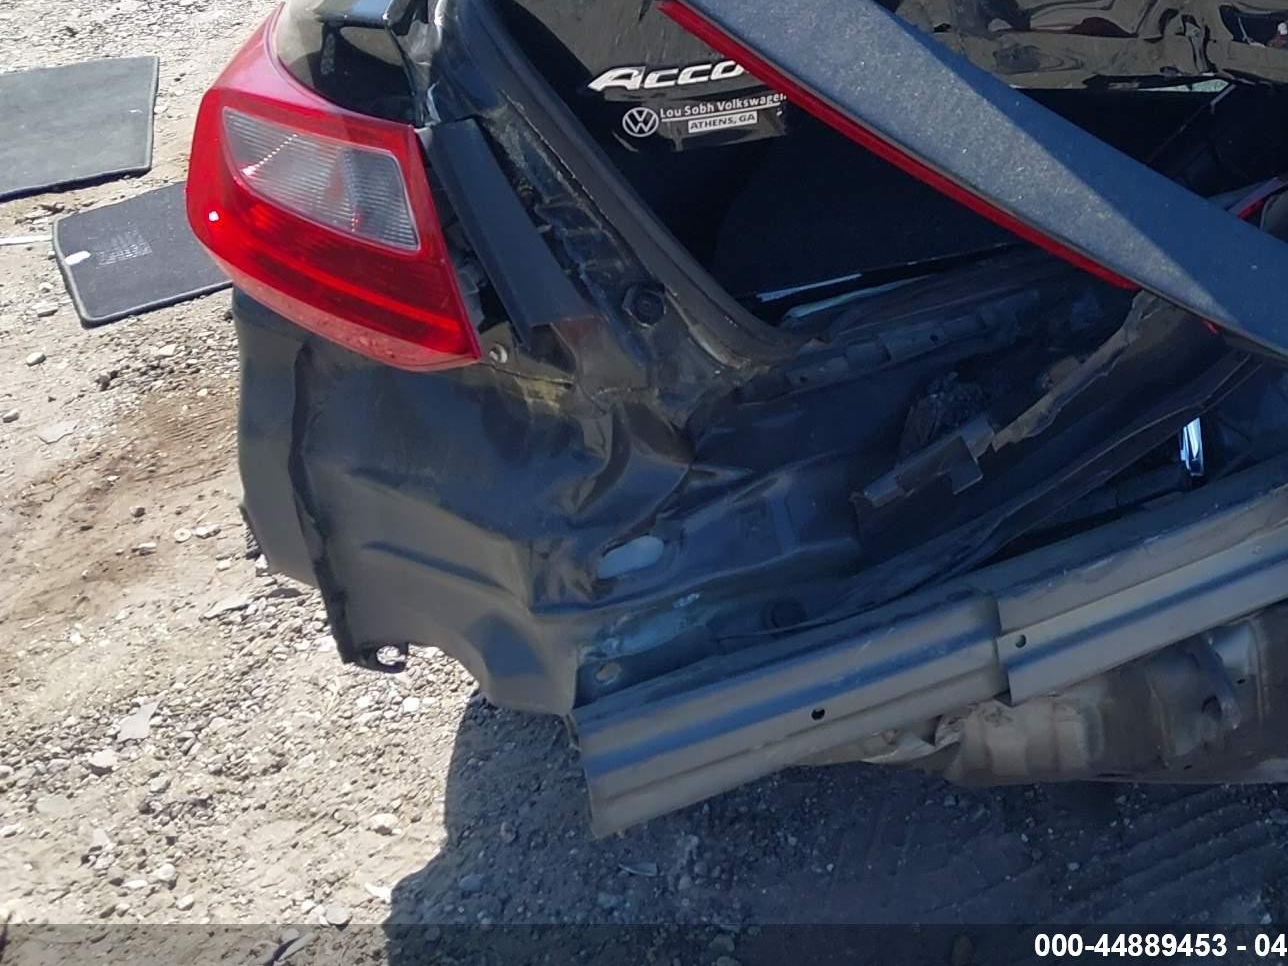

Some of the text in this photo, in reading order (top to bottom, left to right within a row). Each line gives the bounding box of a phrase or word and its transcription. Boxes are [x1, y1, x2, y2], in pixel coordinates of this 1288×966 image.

[660, 107, 682, 119] Lou
[684, 101, 715, 116] Sobh
[689, 114, 756, 130] ATHENS, GA
